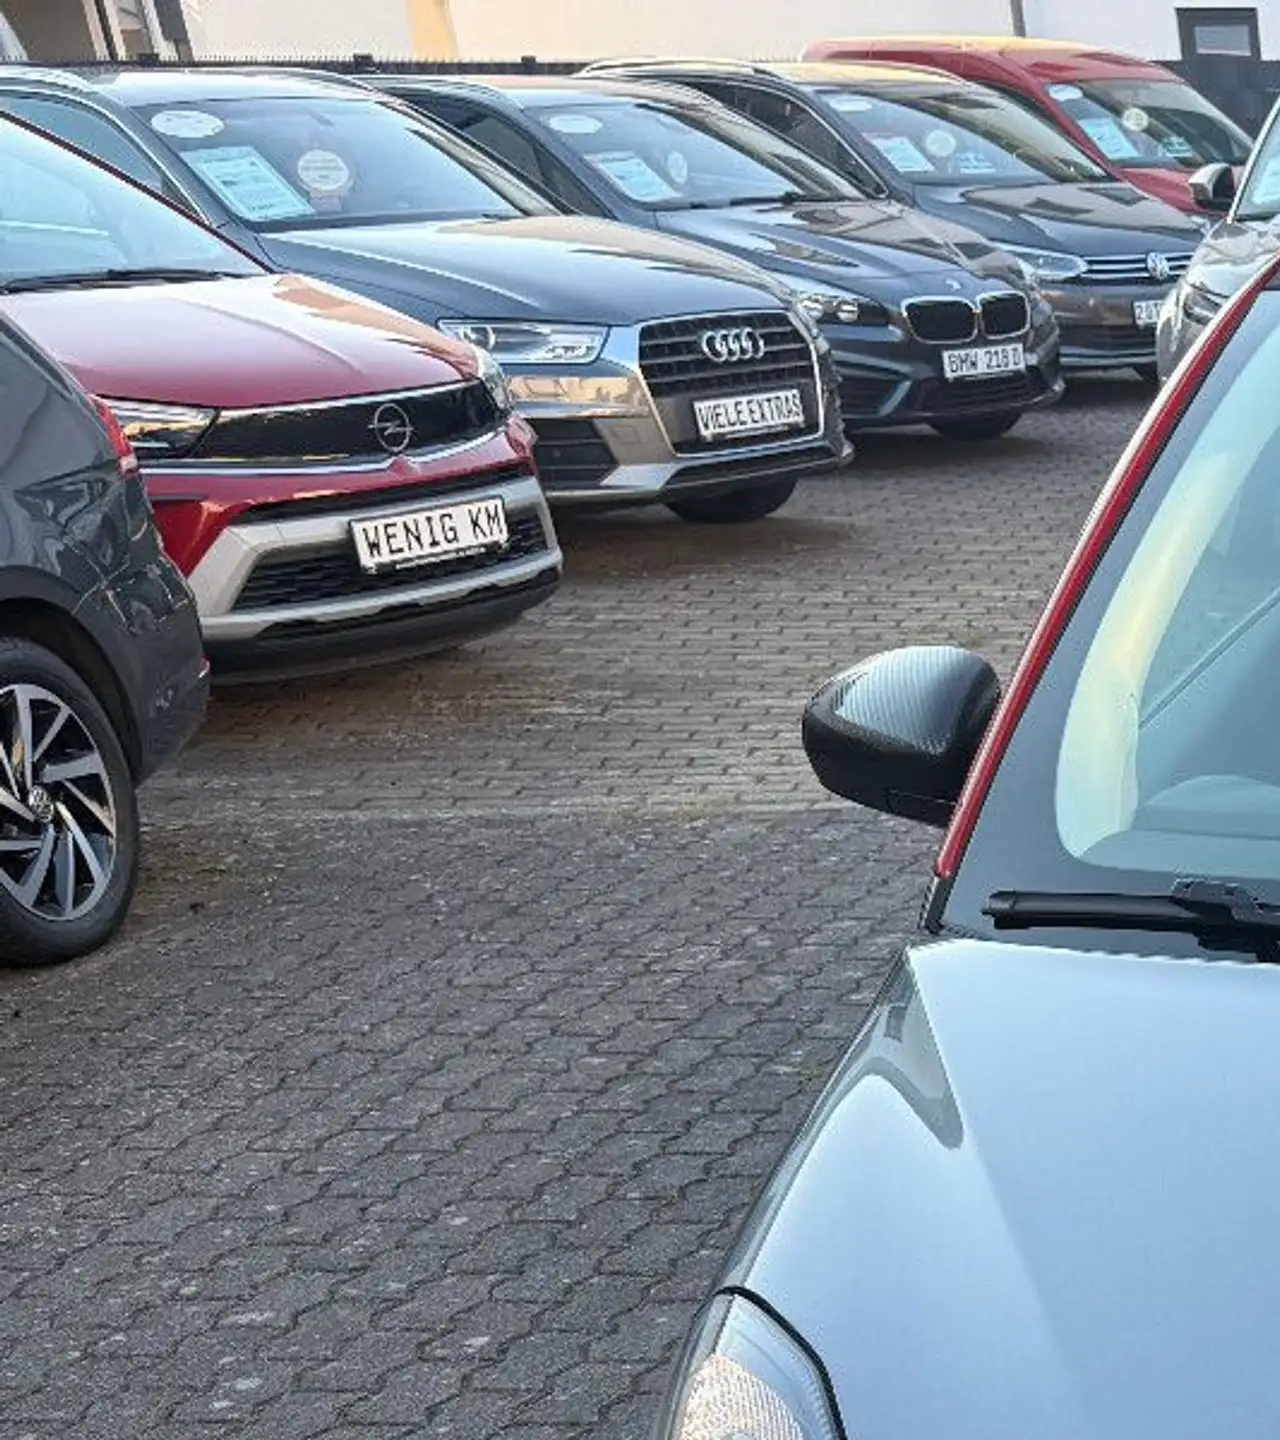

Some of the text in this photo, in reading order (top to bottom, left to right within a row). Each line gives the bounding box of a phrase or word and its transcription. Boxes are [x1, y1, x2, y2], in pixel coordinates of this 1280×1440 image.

[697, 393, 802, 431] VIELE EXTRAS
[362, 504, 504, 558] WENIG KM
